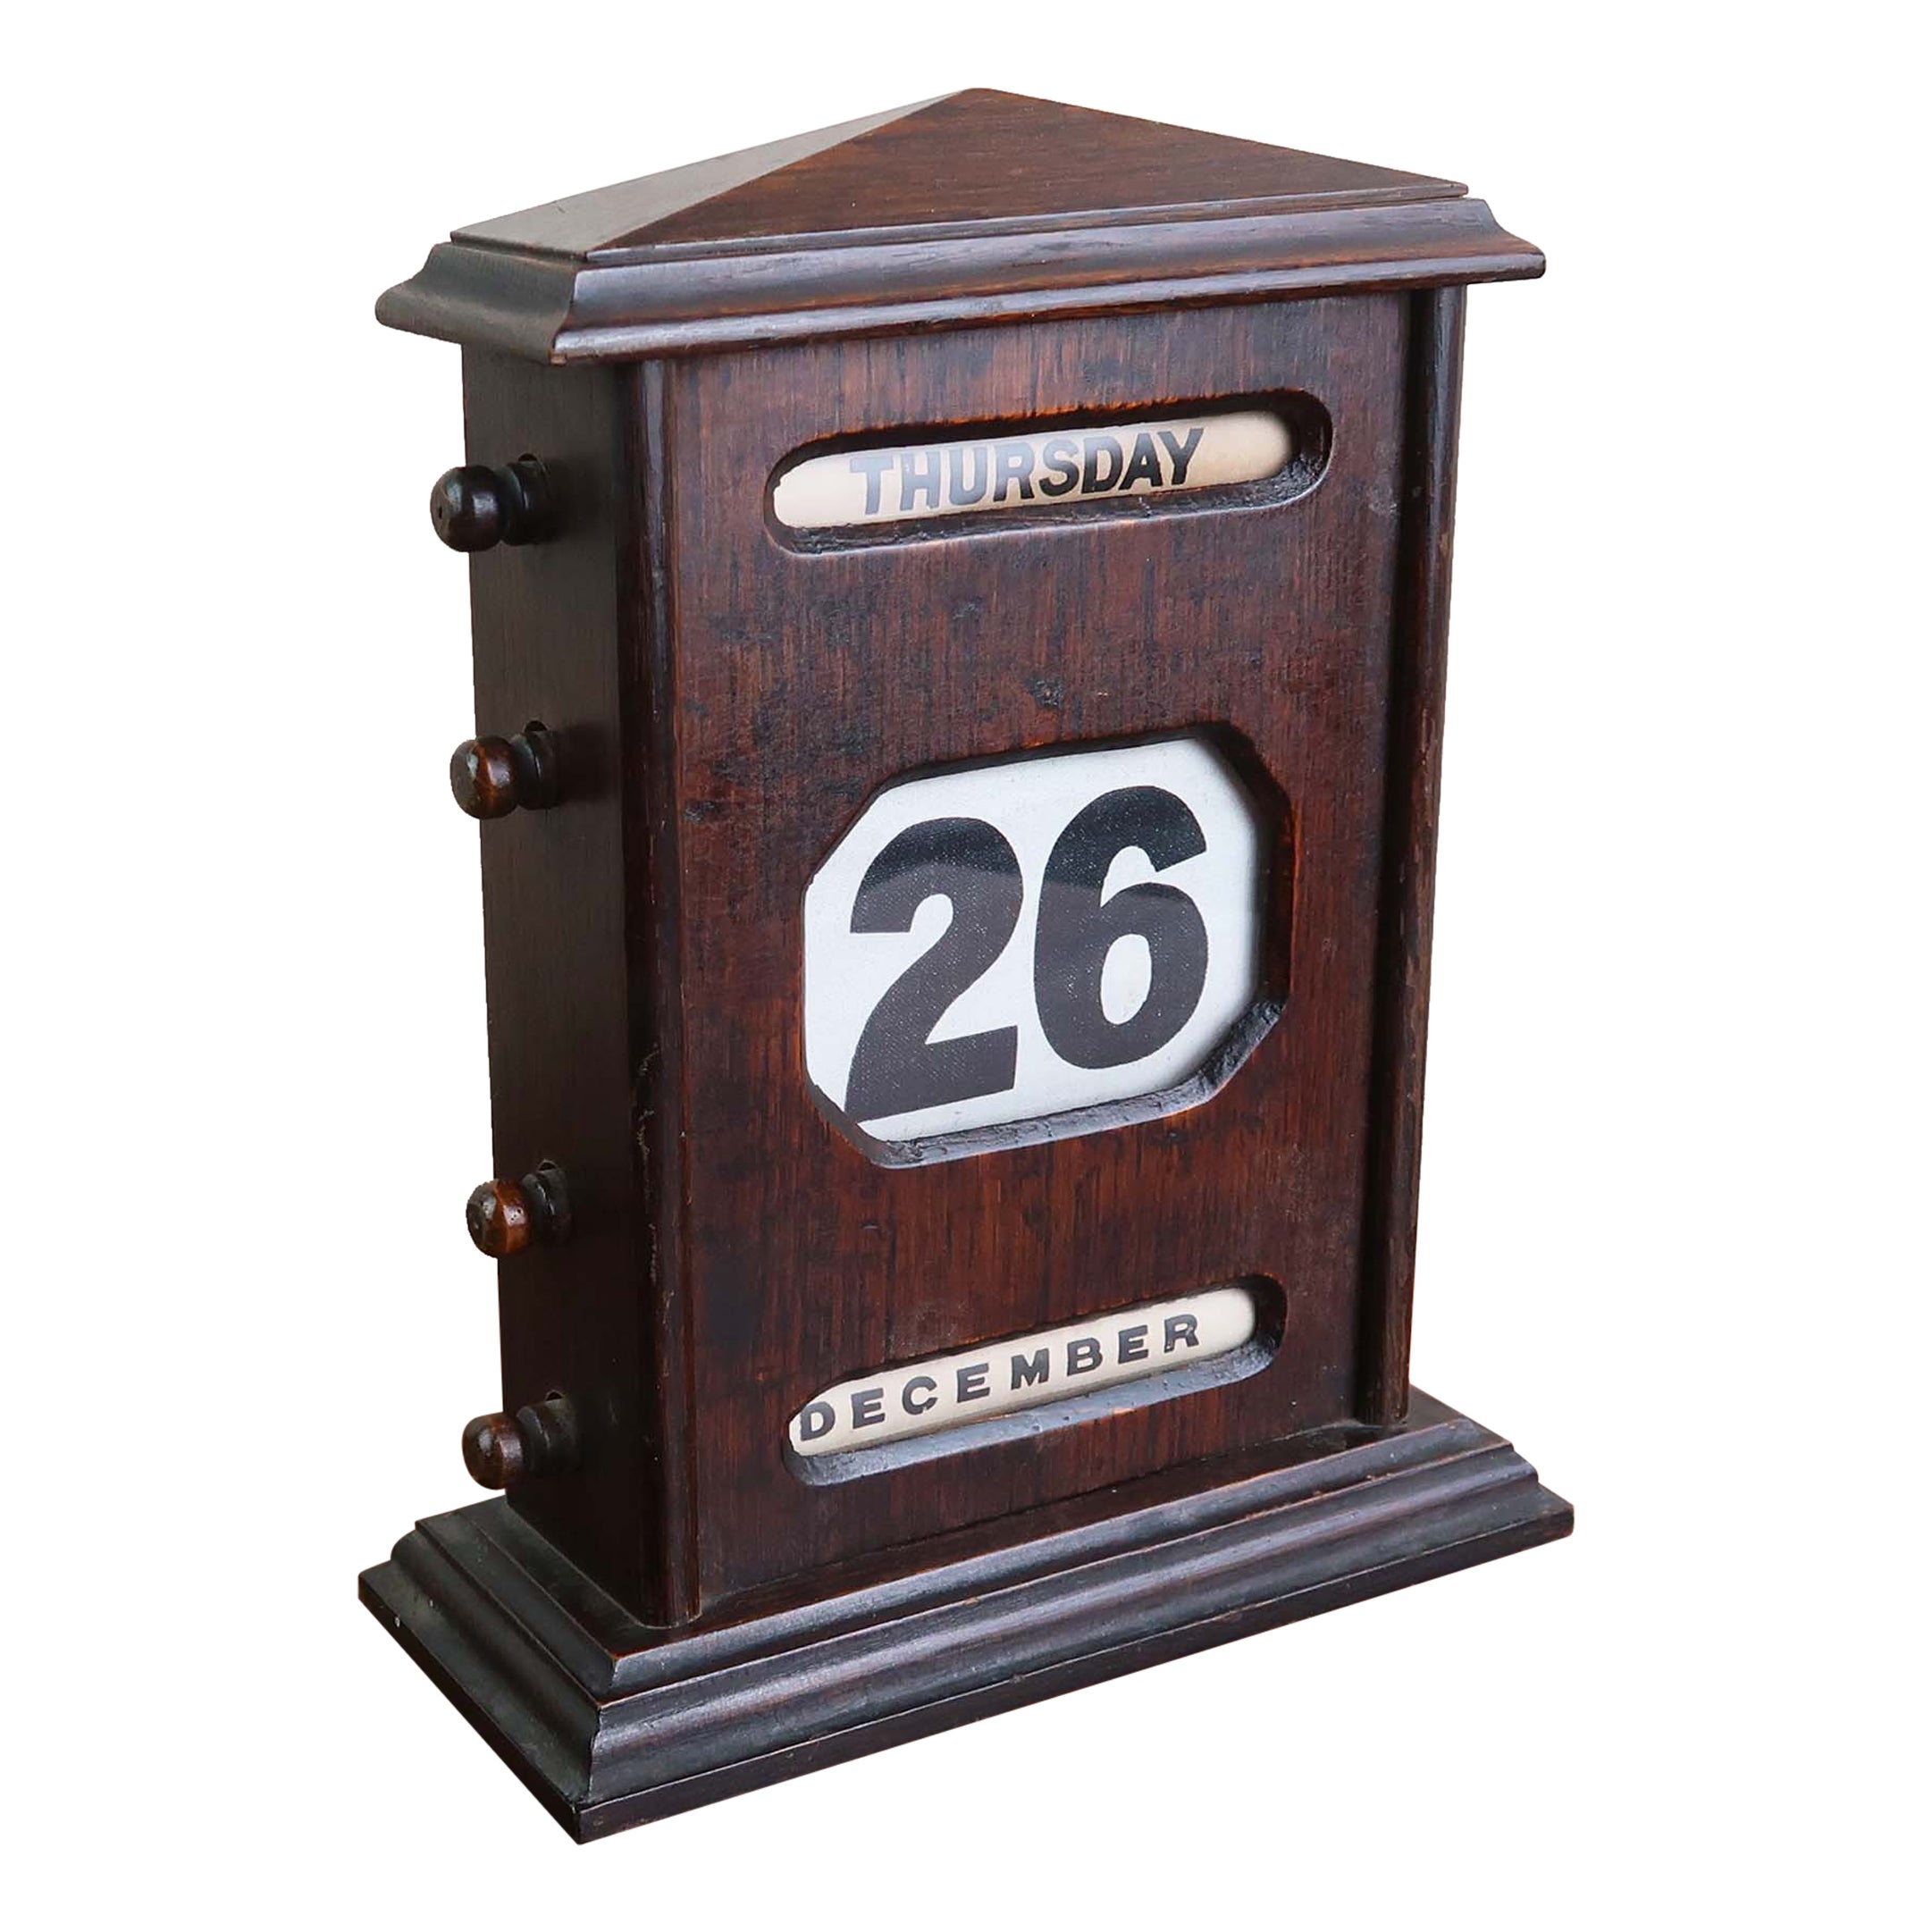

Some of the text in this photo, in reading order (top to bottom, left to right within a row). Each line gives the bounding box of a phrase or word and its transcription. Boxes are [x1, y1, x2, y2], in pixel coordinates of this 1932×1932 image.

[850, 427, 1204, 515] THURSDAY
[844, 785, 1209, 1122] 26
[800, 1314, 1199, 1441] DECEMBER
